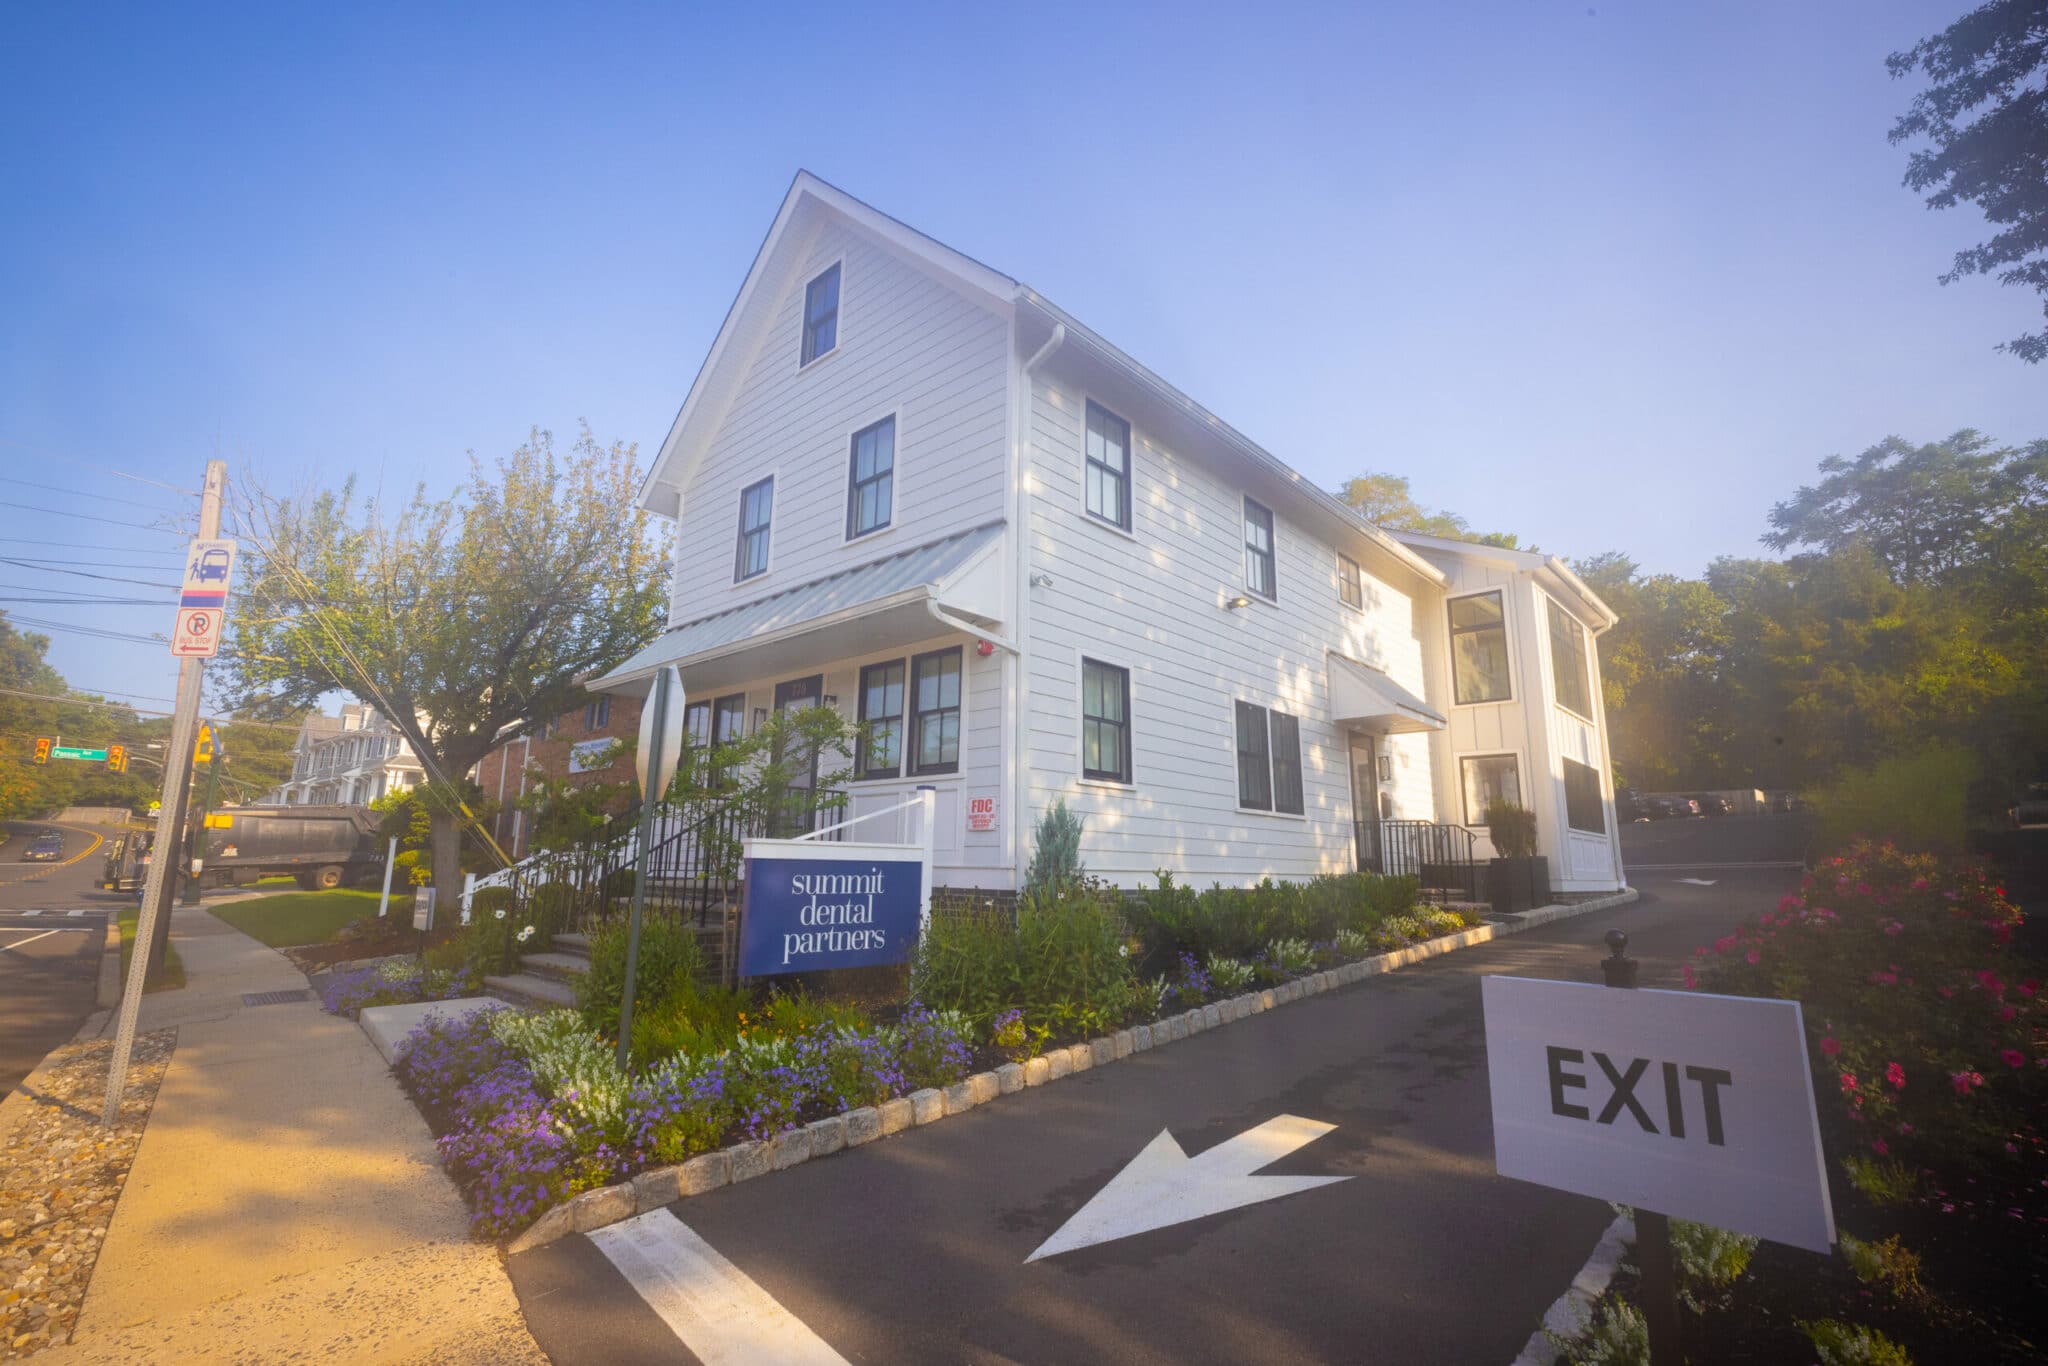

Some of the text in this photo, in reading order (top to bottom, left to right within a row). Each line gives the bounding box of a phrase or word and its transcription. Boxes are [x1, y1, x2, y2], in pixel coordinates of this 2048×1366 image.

[194, 636, 212, 645] STOP
[971, 799, 993, 813] FDC
[791, 867, 885, 895] summit
[800, 894, 873, 926] dental
[782, 929, 886, 965] partners
[1546, 1045, 1733, 1146] EXIT
